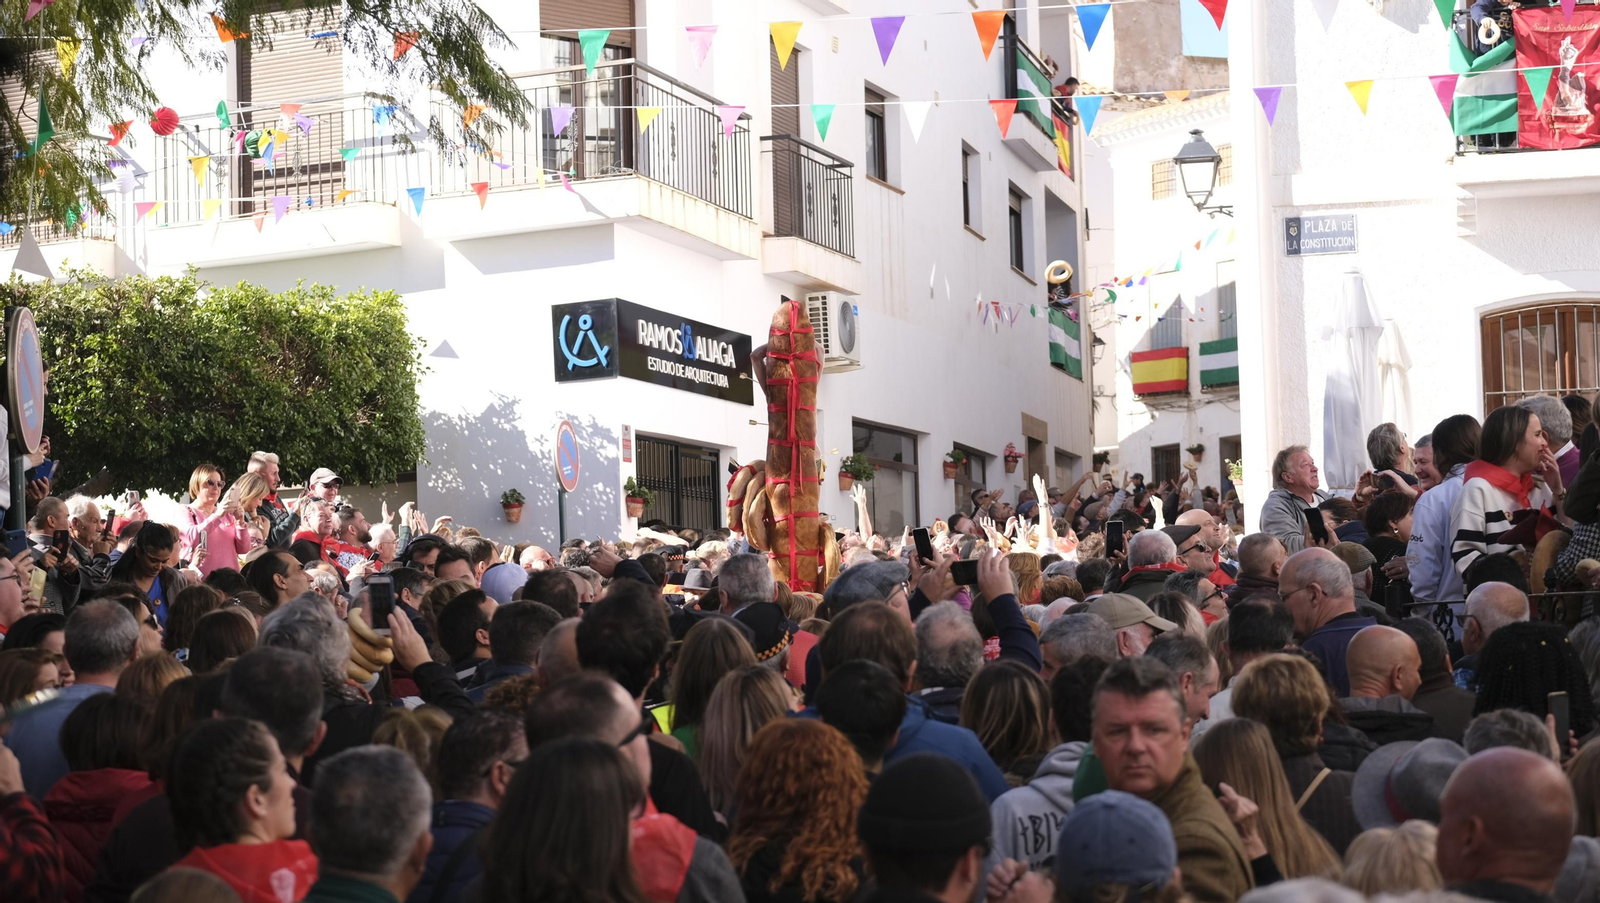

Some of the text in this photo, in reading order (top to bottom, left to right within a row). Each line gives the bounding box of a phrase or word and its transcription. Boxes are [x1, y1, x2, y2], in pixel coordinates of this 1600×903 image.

[1304, 219, 1353, 233] PLAZA DE
[1287, 237, 1354, 250] LA CONSTITUCION
[637, 319, 736, 368] RAMOS ALIAGA
[647, 356, 729, 388] ESTUDIO DE ARQUITECTURA
